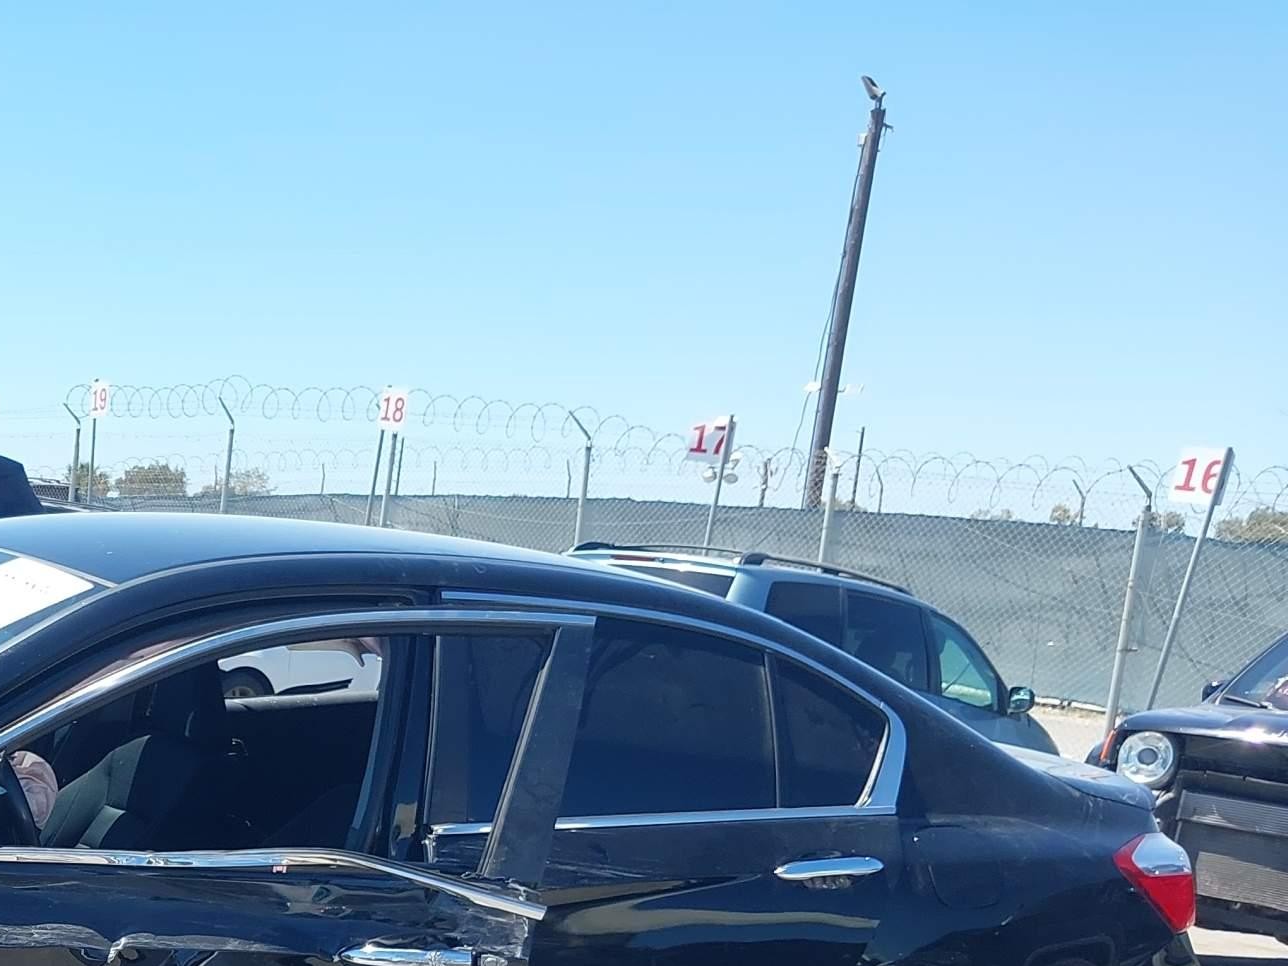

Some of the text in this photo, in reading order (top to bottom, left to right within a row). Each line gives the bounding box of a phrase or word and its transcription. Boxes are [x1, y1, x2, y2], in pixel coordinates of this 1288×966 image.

[92, 388, 107, 411] 19
[380, 396, 405, 423] 18
[689, 423, 727, 456] 17
[1174, 457, 1222, 495] 16
